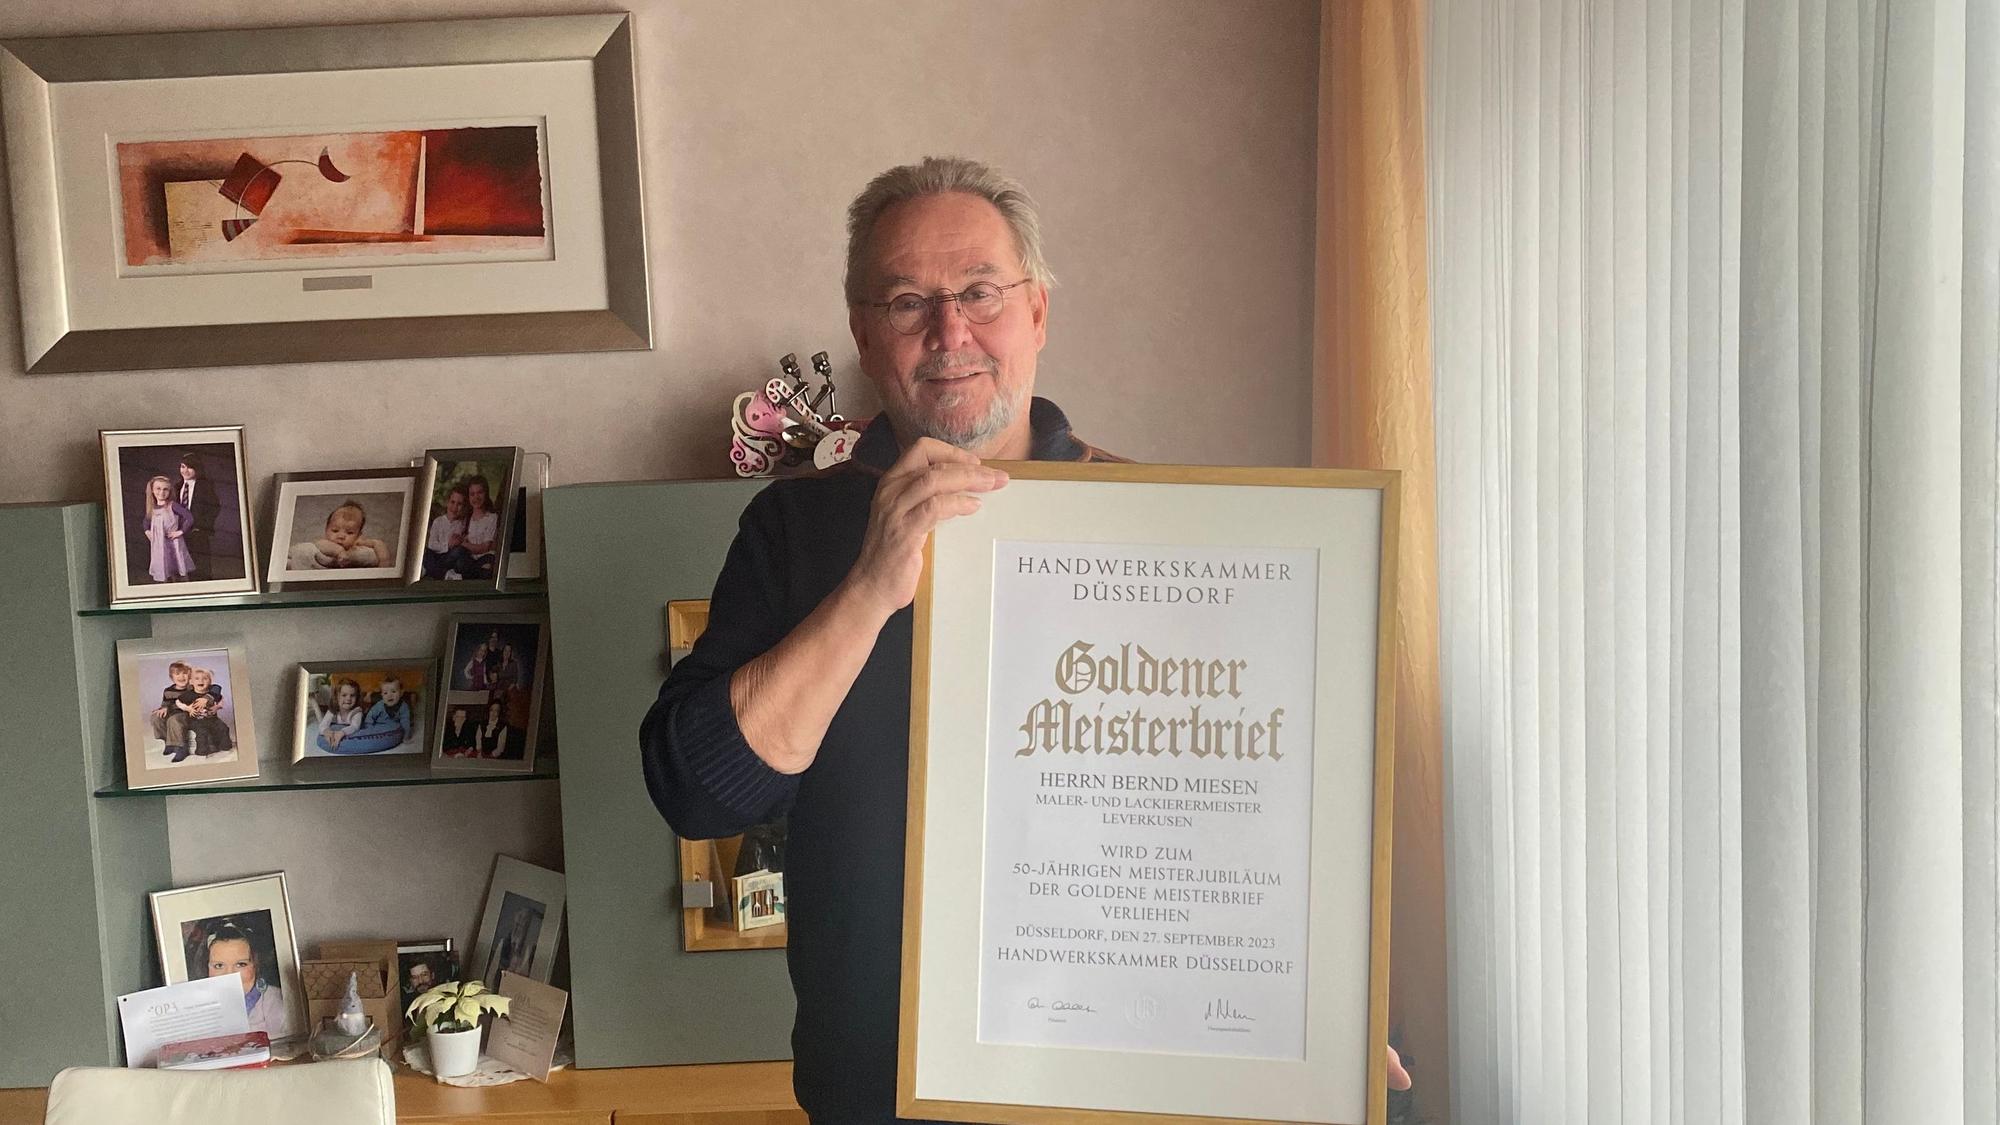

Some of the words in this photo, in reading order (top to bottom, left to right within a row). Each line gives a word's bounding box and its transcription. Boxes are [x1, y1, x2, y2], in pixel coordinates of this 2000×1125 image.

[1018, 557, 1292, 580] HANDWERKSKAMMER
[1073, 581, 1235, 604] DÜSSELDORF
[1055, 640, 1248, 699] Goldener
[1014, 699, 1284, 762] Meisterbrief
[1040, 773, 1106, 789] HERRN
[1111, 775, 1178, 792] BERND
[1184, 778, 1258, 795] MIESEN
[1035, 794, 1088, 806] MALER-
[1091, 795, 1121, 808] UND
[1125, 798, 1262, 814] LACKIERERMEISTER
[1102, 814, 1192, 828] LEVERKUSEN
[1100, 844, 1147, 859] WIRD
[1155, 847, 1192, 861] ZUM
[1013, 860, 1121, 879] 50-JÄHRIGEN
[1128, 865, 1281, 886] MEISTERJUBILÄUM
[1029, 883, 1060, 896] DER
[1068, 884, 1147, 900] GOLDENE
[1154, 888, 1265, 905] MEISTERBRIEF
[1102, 906, 1190, 922] VERLIEHEN
[1015, 924, 1107, 942] DÜSSELDORF,
[1111, 930, 1139, 943] DEN
[1143, 931, 1161, 944] 27.
[1164, 932, 1243, 947] SEPTEMBER
[1247, 936, 1275, 949] 2023
[998, 947, 1178, 969] HANDWERKSKAMMER
[1186, 955, 1294, 974] DÜSSELDORF
